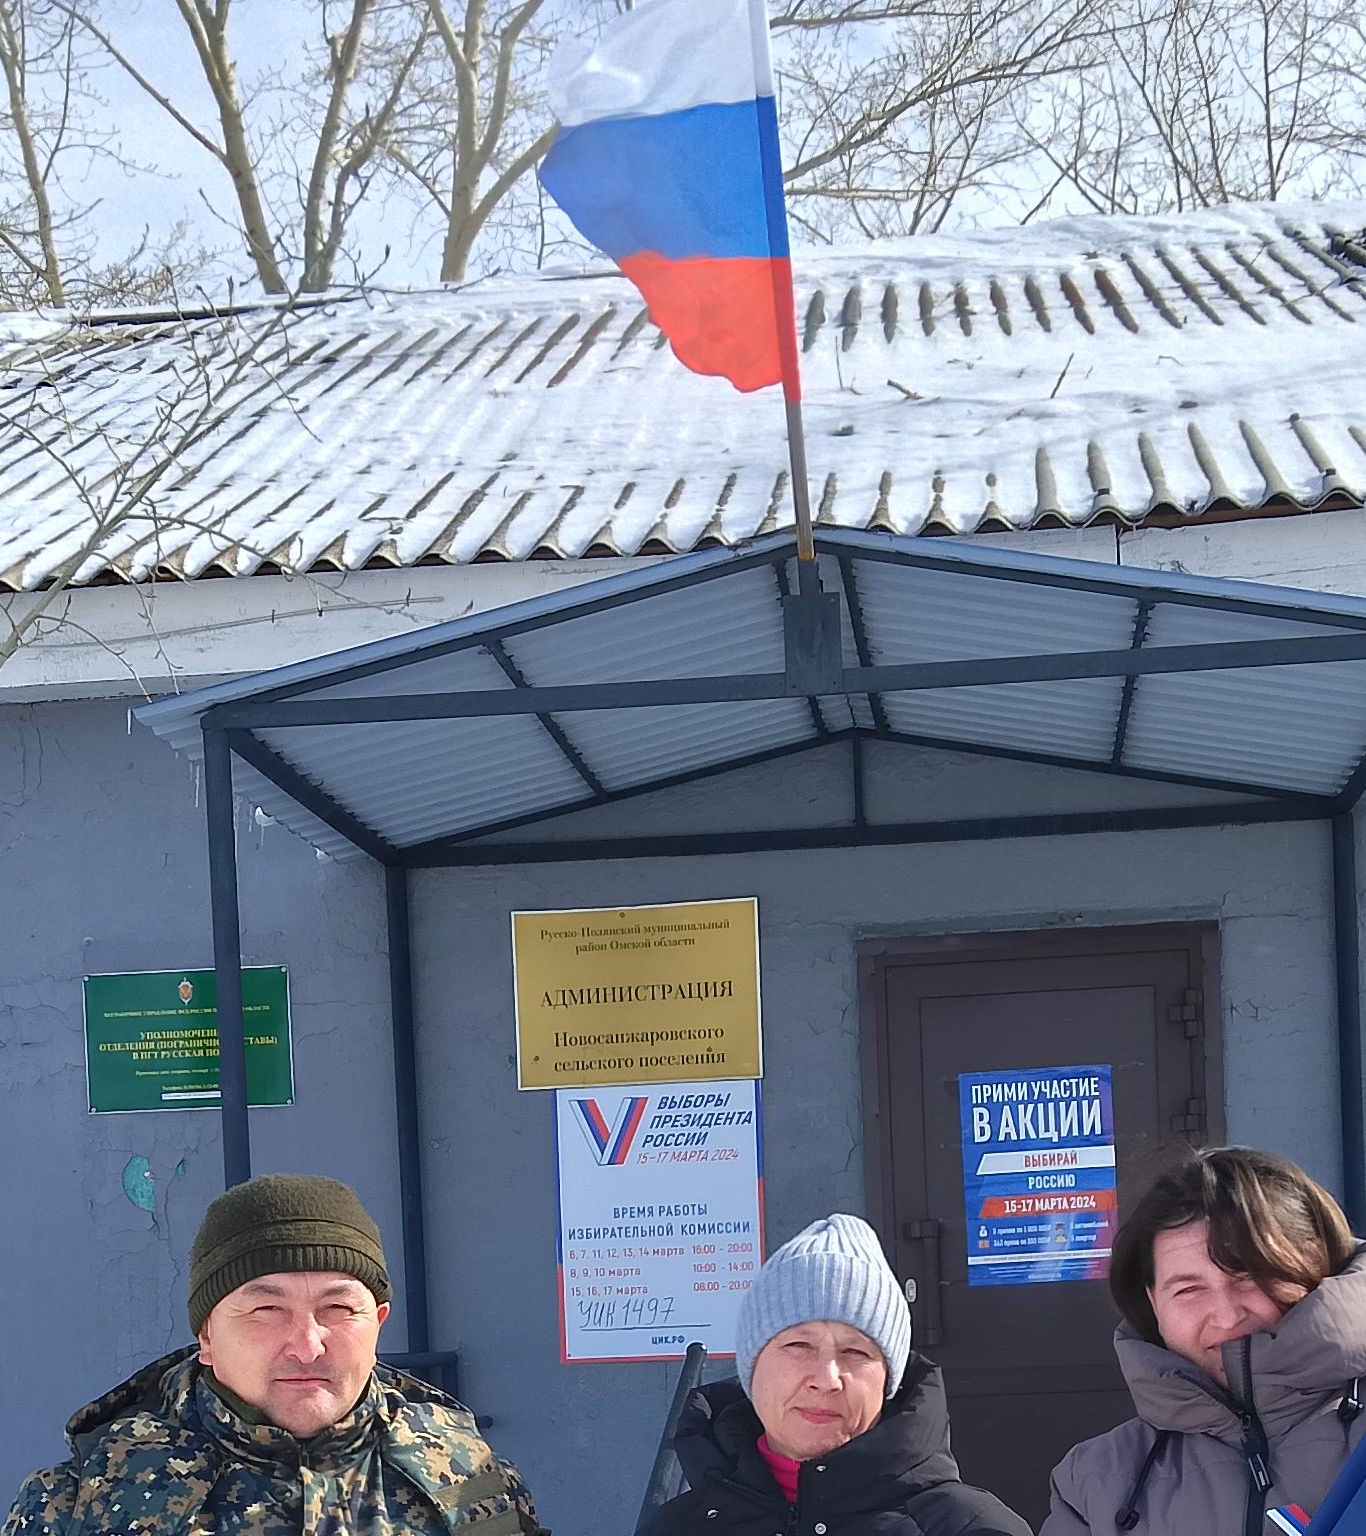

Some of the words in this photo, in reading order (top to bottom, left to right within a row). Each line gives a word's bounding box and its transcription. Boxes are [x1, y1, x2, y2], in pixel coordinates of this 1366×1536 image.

[540, 924, 641, 942] Русско-Полянский
[643, 919, 730, 936] муниципальный
[575, 942, 607, 955] район
[610, 938, 651, 950] Омской
[654, 937, 695, 948] области
[540, 980, 734, 1009] АДМИНИСТРАЦИЯ
[554, 1026, 725, 1048] Новосанжаровского
[99, 1041, 155, 1052] ОТДЕЛЕНИЯ
[132, 1052, 139, 1060] В
[141, 1051, 158, 1060] ПГТ
[160, 1049, 204, 1059] РУССКАЯ
[554, 1055, 634, 1072] сельского
[639, 1051, 726, 1069] поселения
[971, 1082, 1028, 1104] ПРИМИ
[1031, 1077, 1100, 1100] УЧАСТИЕ
[657, 1093, 731, 1110] ВЫБОРЫ
[649, 1110, 753, 1129] ПРЕЗИДЕНТА
[973, 1107, 991, 1143] В
[998, 1099, 1102, 1142] АКЦИИ
[642, 1131, 708, 1148] РОССИИ
[669, 1150, 708, 1163] МАРТА
[710, 1148, 739, 1162] 2024
[1024, 1150, 1078, 1168] ВЫБИРАЙ
[1028, 1174, 1076, 1190] РОССИЮ
[613, 1206, 654, 1219] ВРЕМЯ
[658, 1203, 708, 1217] РАБОТЫ
[1004, 1198, 1033, 1213] 15-17
[1035, 1197, 1069, 1211] МАРТА
[1070, 1195, 1096, 1210] 2024
[568, 1222, 674, 1241] ИЗБИРАТЕЛЬНОЙ
[569, 1250, 578, 1260] 6,
[581, 1250, 590, 1260] 7,
[592, 1249, 602, 1259] 11,
[607, 1248, 619, 1259] 12,
[623, 1248, 636, 1258] 13,
[639, 1246, 650, 1256] 14
[652, 1247, 685, 1258] марта
[727, 1242, 753, 1253] 20:00
[570, 1268, 579, 1278] 8,
[582, 1268, 592, 1278] 9,
[594, 1267, 605, 1277] 10
[608, 1267, 641, 1278] марта
[692, 1263, 716, 1273] 10:00
[728, 1261, 754, 1271] 14:00
[571, 1287, 583, 1297] 15,
[587, 1286, 601, 1297] 16,
[604, 1286, 613, 1295] 17
[616, 1285, 648, 1297] марта
[577, 1300, 616, 1328] УИК
[622, 1297, 675, 1327] 1497
[651, 1335, 685, 1346] ЦИК.РФ
